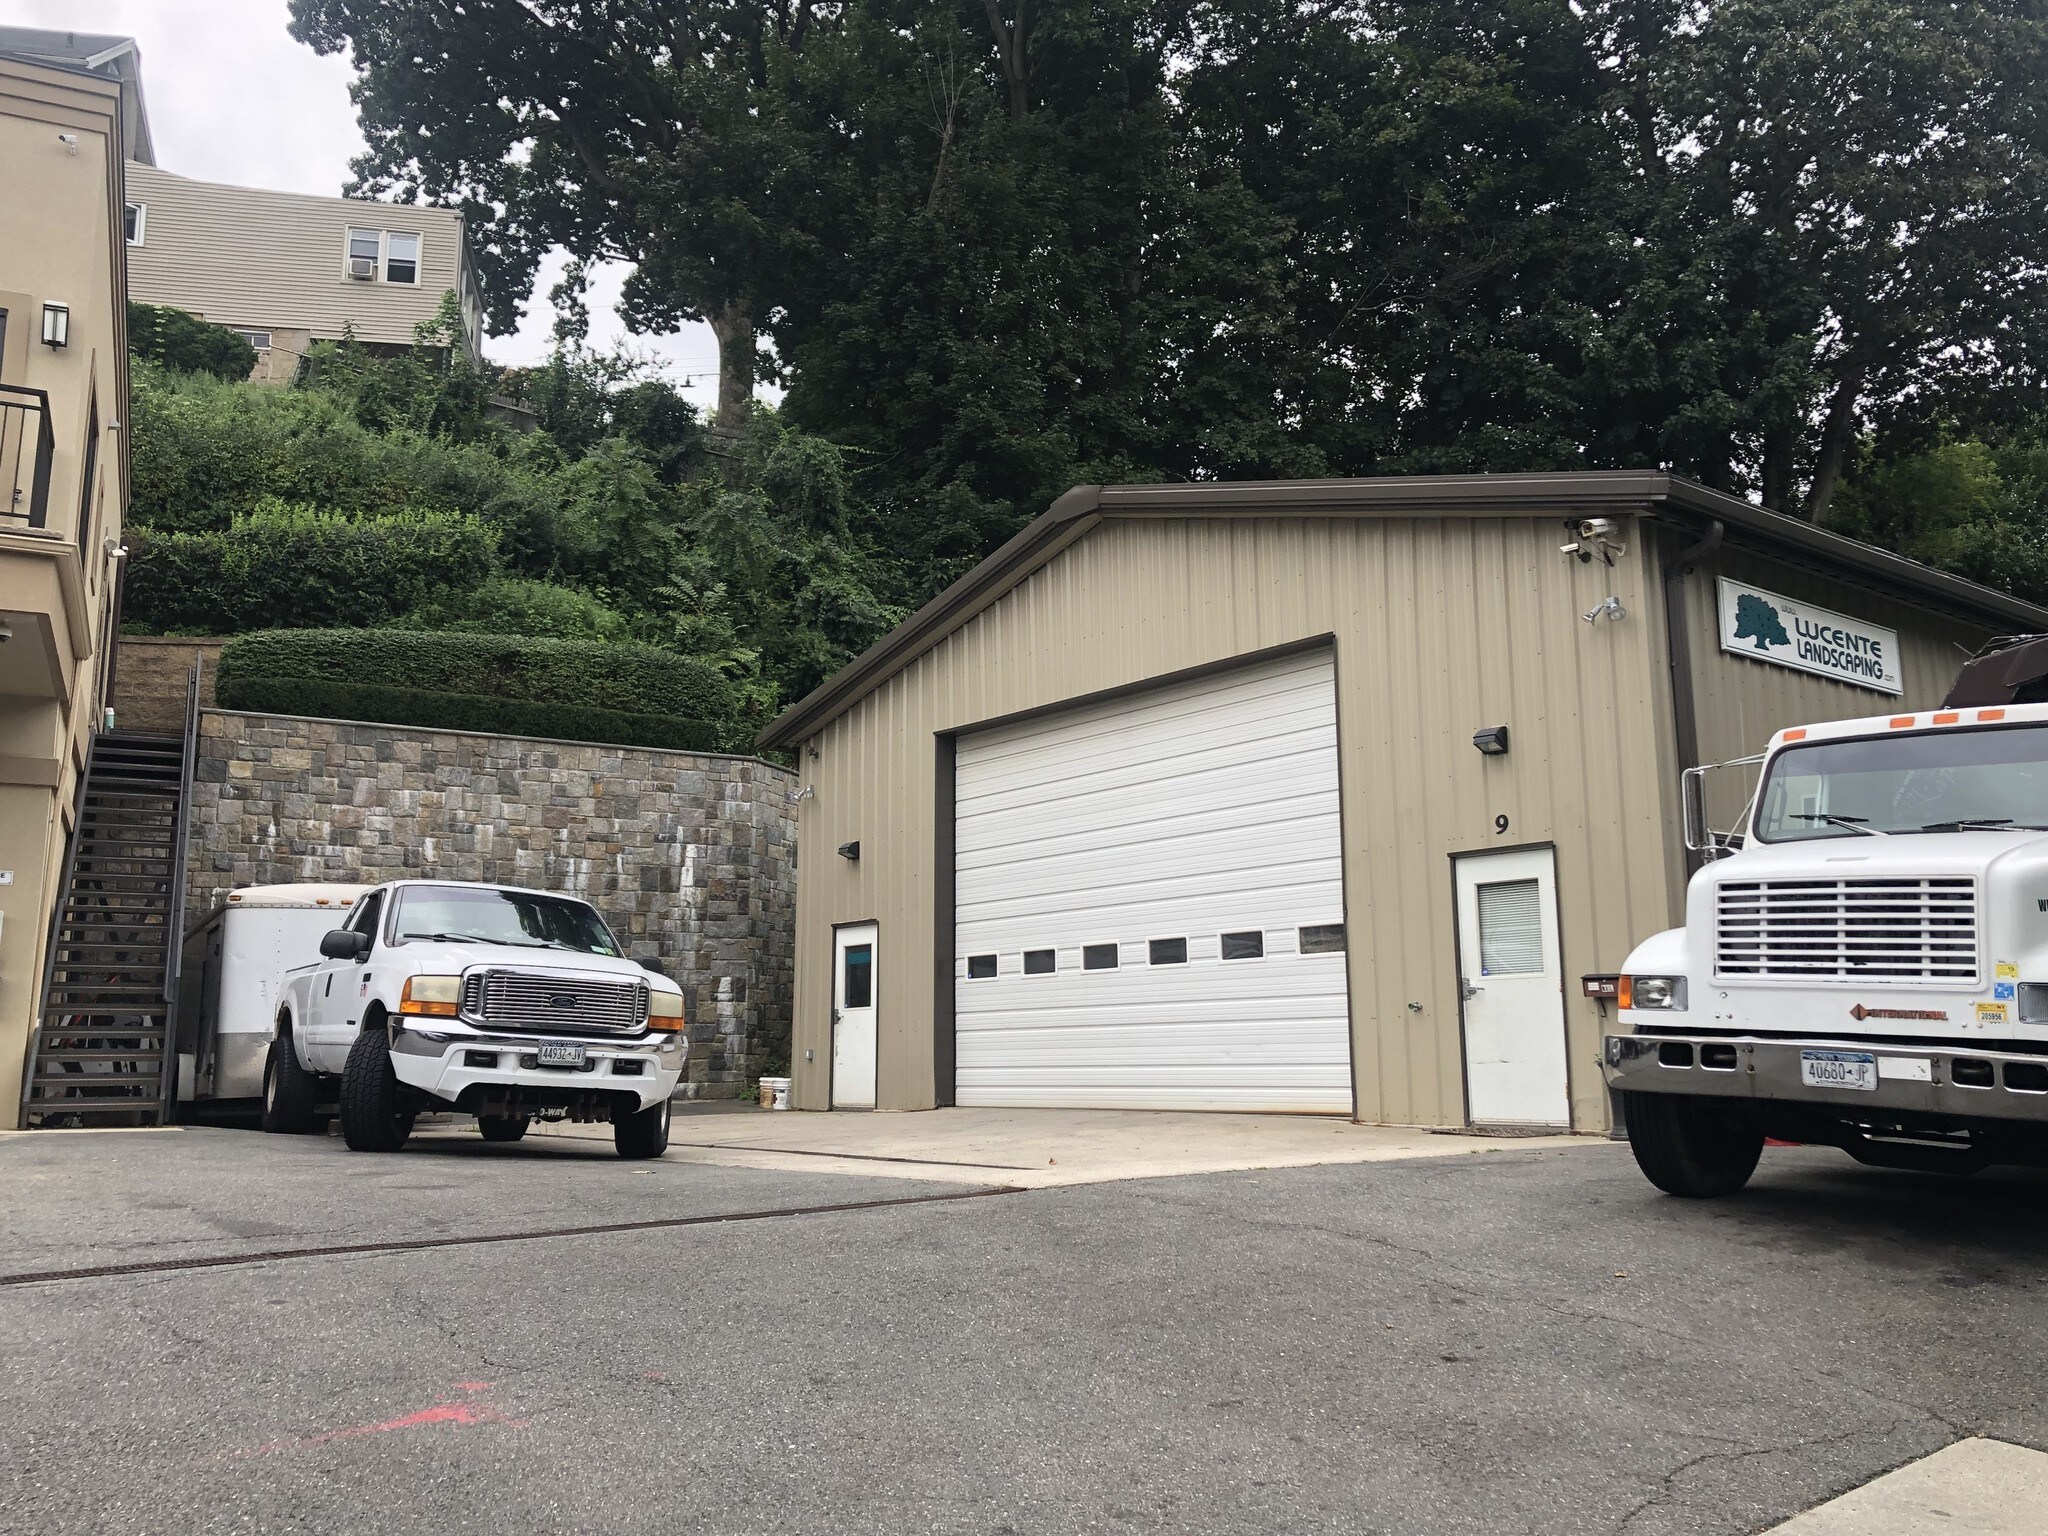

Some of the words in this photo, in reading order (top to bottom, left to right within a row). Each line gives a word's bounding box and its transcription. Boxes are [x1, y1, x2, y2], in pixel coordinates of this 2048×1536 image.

[1795, 617, 1882, 659] LUCENTE
[1797, 638, 1883, 680] LANDSCAPING
[1495, 814, 1509, 835] 9
